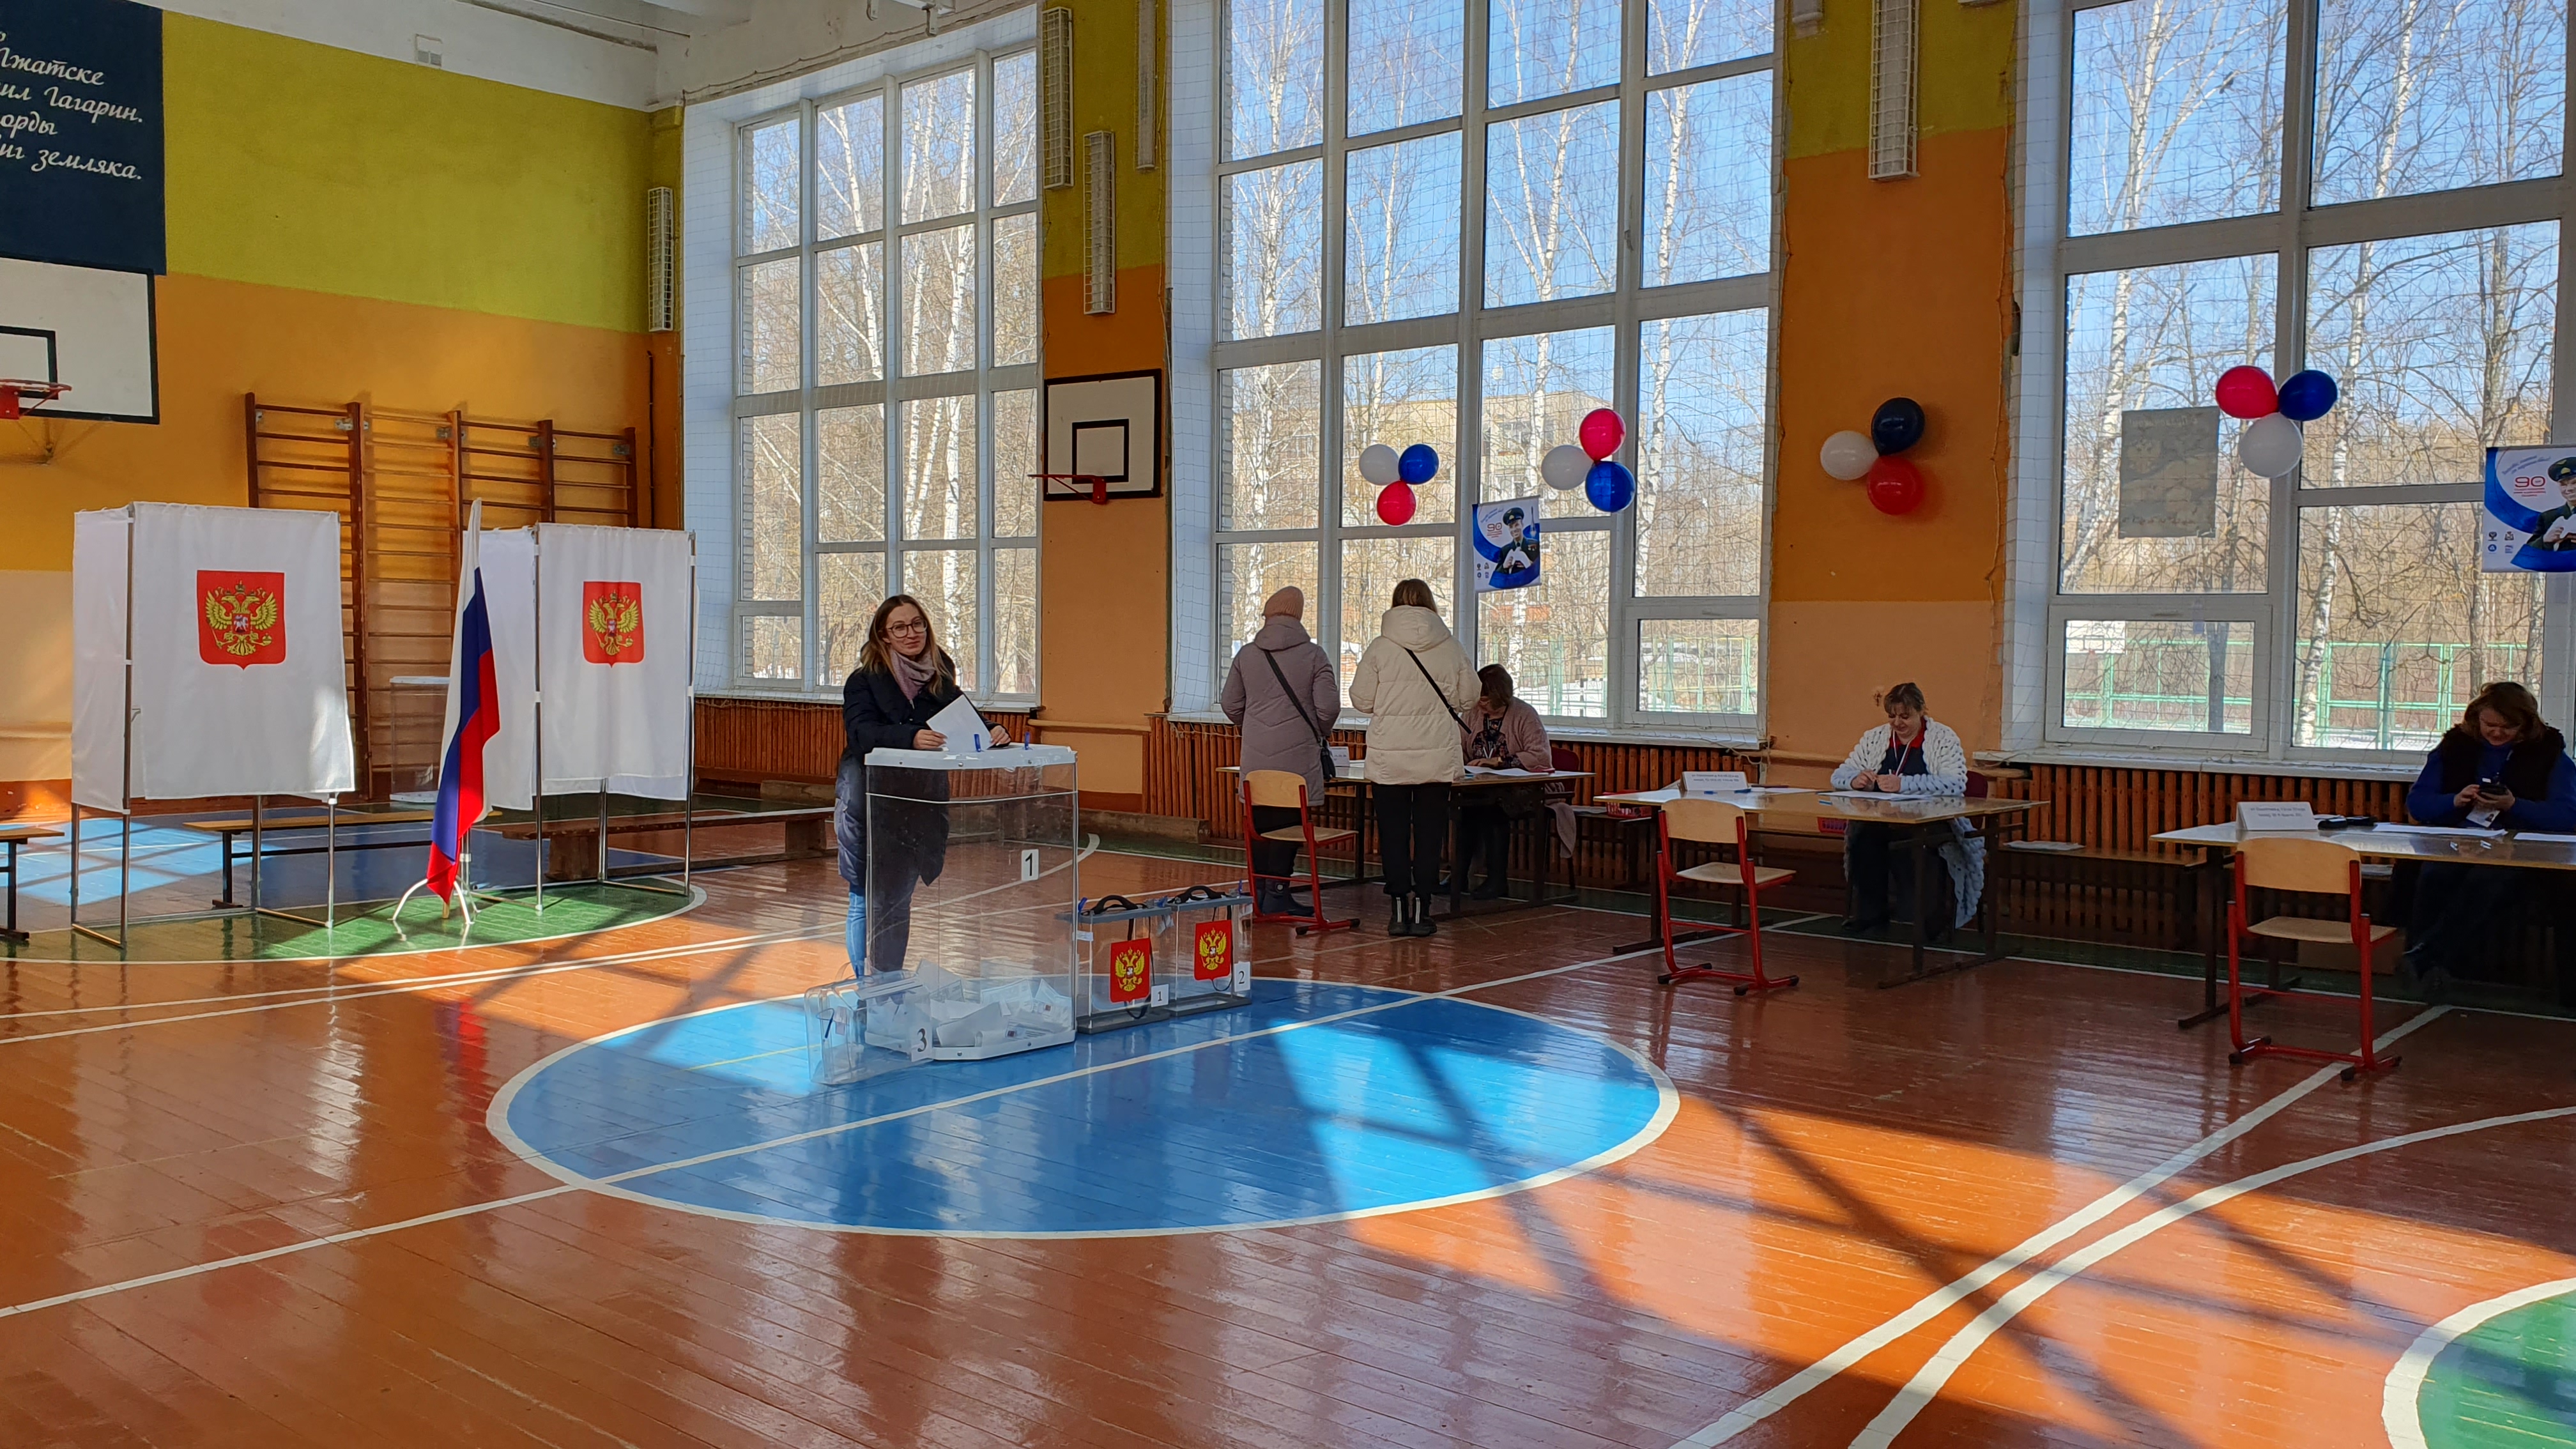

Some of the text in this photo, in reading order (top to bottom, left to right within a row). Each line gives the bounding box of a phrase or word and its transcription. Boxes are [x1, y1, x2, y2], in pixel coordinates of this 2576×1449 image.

[0, 82, 143, 123] ил Гагарин.
[0, 111, 58, 139] орды
[0, 142, 142, 180] иг земляка.
[2515, 476, 2545, 487] 90
[1487, 523, 1502, 532] 90
[1025, 852, 1033, 877] 1
[1238, 970, 1245, 985] 2
[1157, 991, 1163, 1002] 1
[917, 1028, 928, 1052] 3
